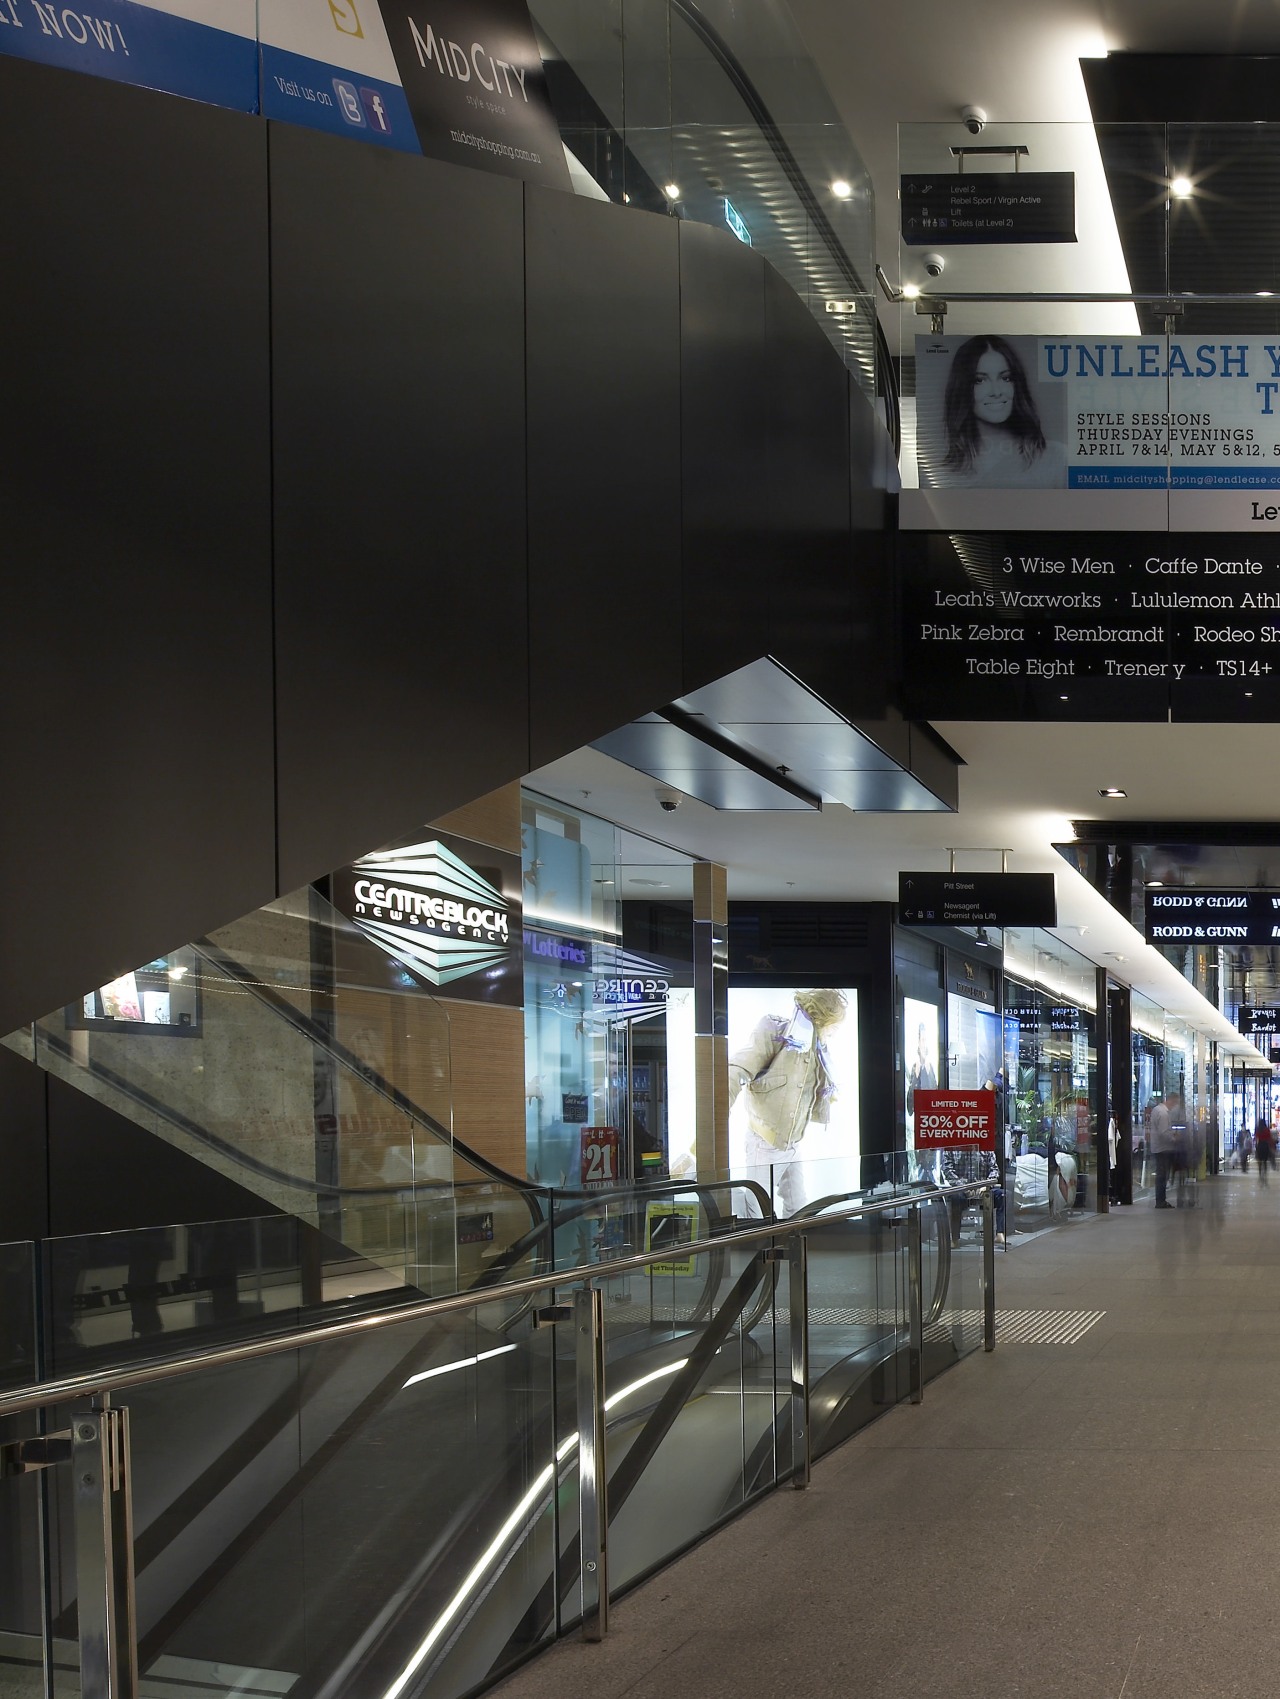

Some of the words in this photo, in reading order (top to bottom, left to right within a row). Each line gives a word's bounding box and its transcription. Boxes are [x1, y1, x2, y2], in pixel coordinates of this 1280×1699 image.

[31, 0, 130, 56] NOW!
[274, 76, 301, 98] Visit
[300, 88, 316, 101] us
[316, 92, 333, 107] on
[450, 129, 542, 164] midcityshopping.com.au
[972, 197, 992, 205] Sport
[998, 196, 1018, 206] Virgin
[1019, 196, 1041, 204] Active
[950, 208, 962, 216] Lift
[951, 219, 974, 227] Toilets
[975, 219, 985, 228] (at
[986, 219, 1004, 227] Level
[1004, 219, 1014, 228] 2)
[1044, 344, 1249, 378] UNLEASH
[1077, 413, 1125, 425] STYLE
[1131, 413, 1211, 426] SESSIONS
[1077, 428, 1163, 441] THURSDAY
[1169, 429, 1255, 441] EVENINGS
[1077, 444, 1125, 456] APRIL
[1180, 444, 1216, 456] MAY
[1077, 475, 1110, 483] EMAIL
[1002, 557, 1013, 573] 3
[1019, 557, 1066, 574] Wise
[1071, 557, 1116, 574] Men
[1145, 557, 1198, 574] Caffe
[1204, 558, 1263, 575] Dante
[934, 590, 995, 607] Leah's
[1000, 591, 1102, 608] Waxworks
[1131, 591, 1234, 609] Lululemon
[920, 624, 963, 640] Pink
[968, 624, 1025, 641] Zebra
[1054, 625, 1165, 642] Rembrandt
[1194, 626, 1255, 642] Rodeo
[966, 658, 1021, 675] Table
[1026, 658, 1075, 679] Eight
[1216, 660, 1273, 676] TS14+
[943, 882, 954, 890] Pitt
[955, 882, 975, 890] Street
[354, 879, 509, 934] CENTREBLOCK
[944, 902, 980, 911] Newsagent
[943, 912, 970, 920] Chemist
[971, 912, 984, 921] (via
[984, 912, 997, 921] Lift)
[1152, 926, 1193, 937] RODD
[1194, 926, 1206, 937] &
[1206, 926, 1248, 938] GUNN
[531, 933, 586, 964] Lotteries
[1250, 1023, 1277, 1032] Bardot
[931, 1100, 959, 1108] LIMITED
[961, 1100, 978, 1108] TIME
[919, 1115, 953, 1129] 30%
[955, 1115, 989, 1129] OFF
